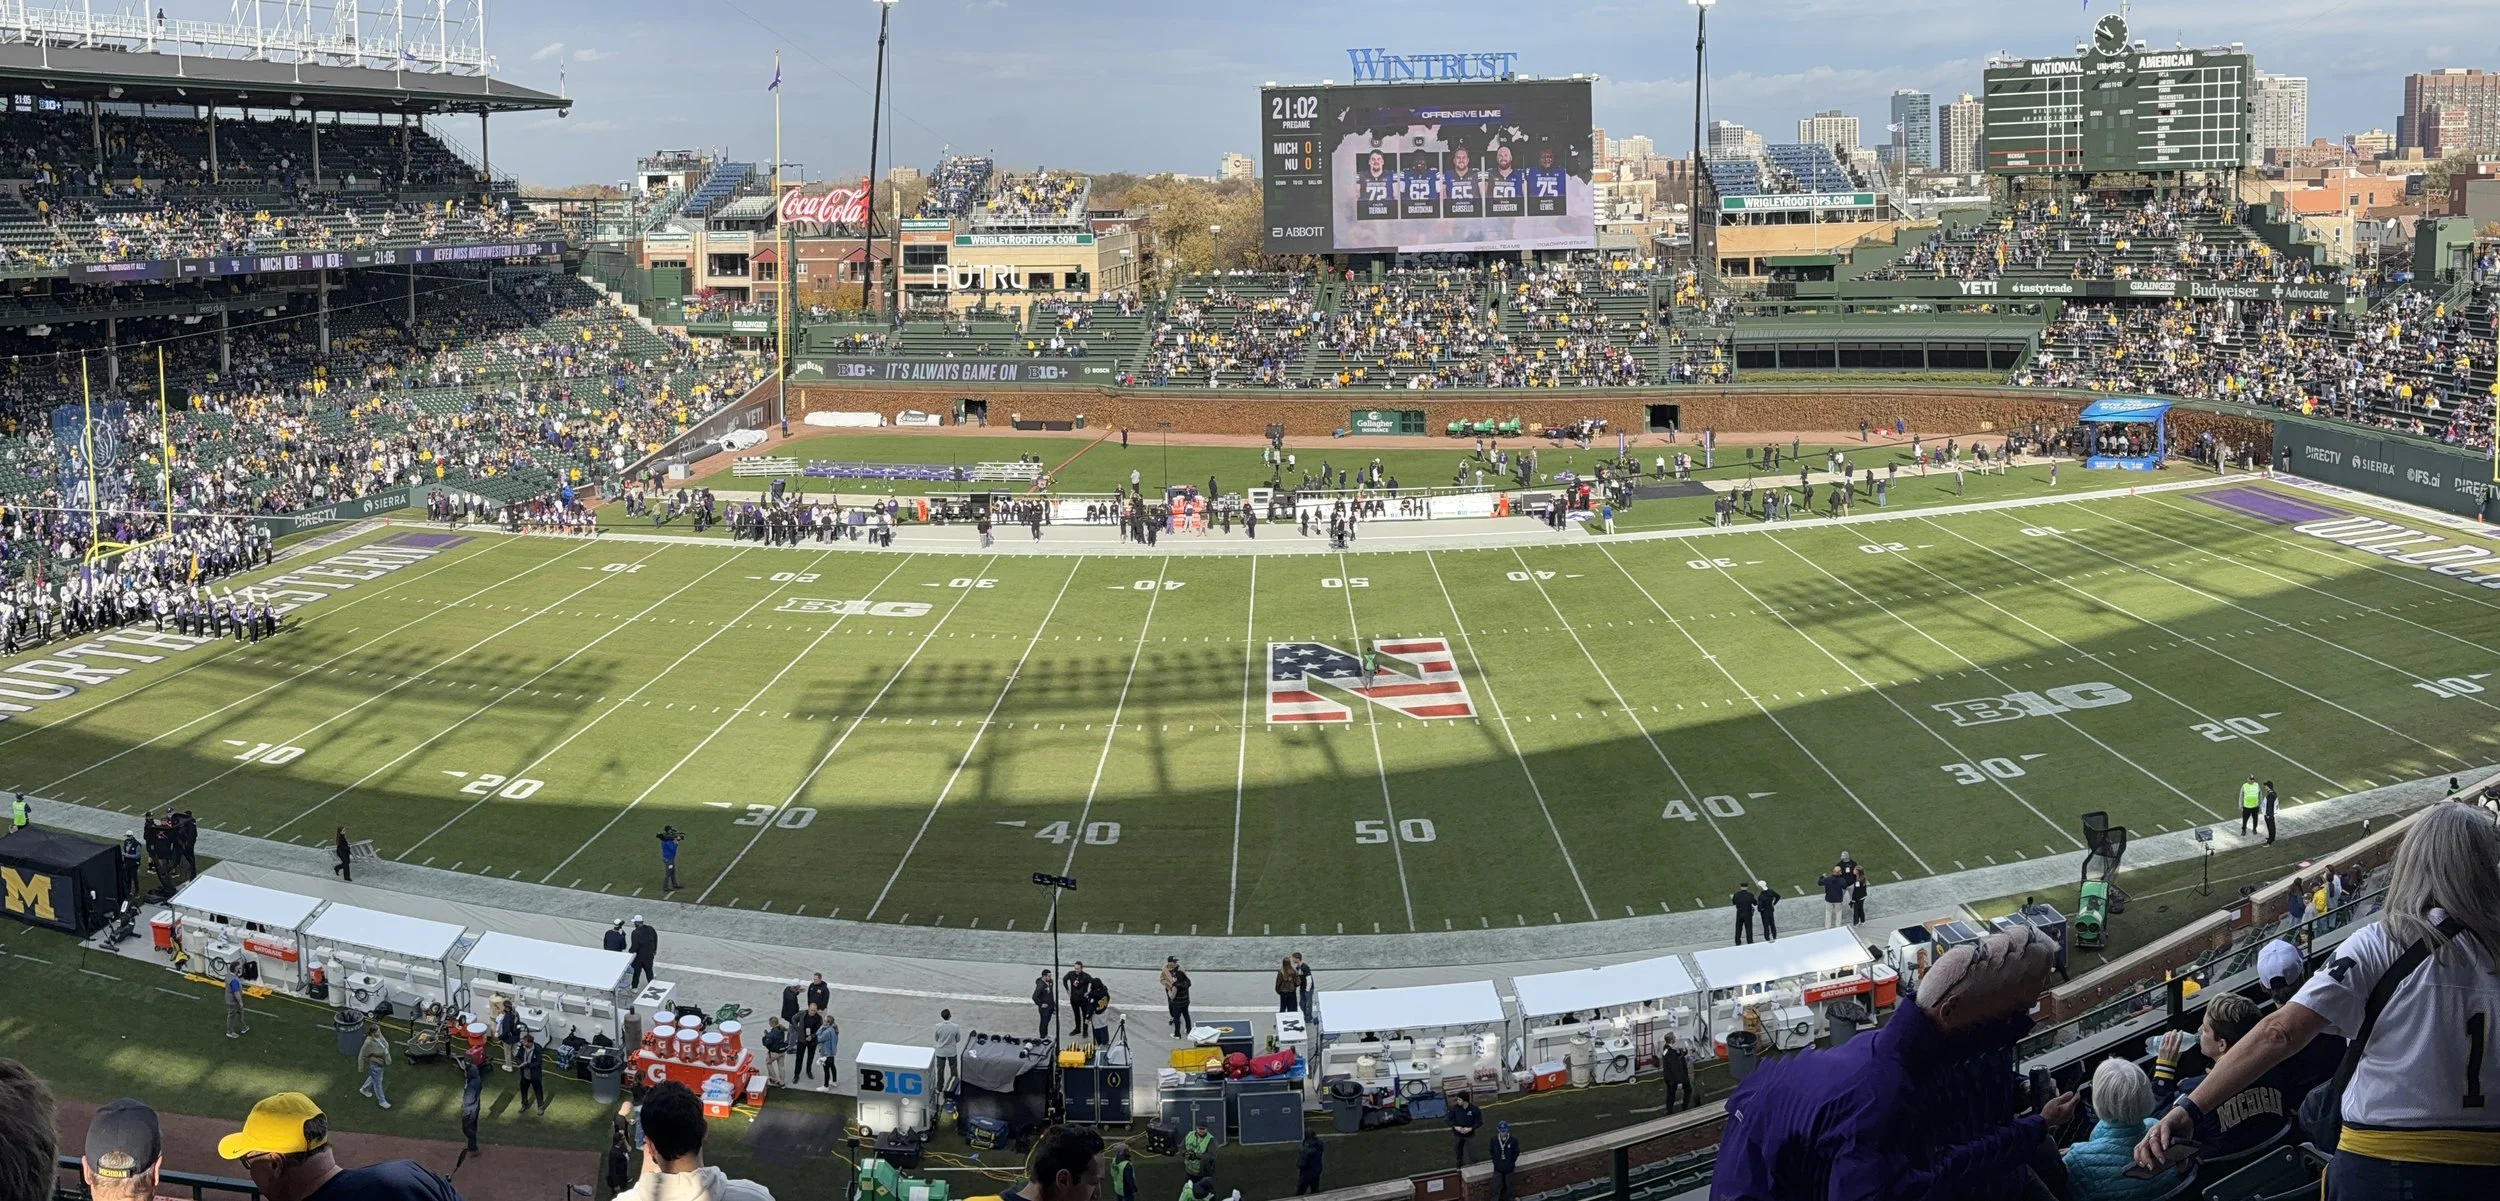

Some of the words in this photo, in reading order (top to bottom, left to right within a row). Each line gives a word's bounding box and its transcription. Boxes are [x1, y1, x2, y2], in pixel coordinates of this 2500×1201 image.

[1347, 48, 1518, 82] WINTRUST
[2032, 61, 2084, 75] NATIONAL
[2139, 54, 2194, 69] AMERICAN
[1272, 96, 1318, 119] 21:02
[1422, 110, 1477, 119] OFFENSIVE
[1478, 109, 1502, 118] LINE
[1282, 120, 1310, 128] PREGAME
[1274, 142, 1298, 155] MICH
[1304, 141, 1312, 154] 0
[1284, 158, 1298, 171] NU
[1304, 157, 1312, 170] 0
[1366, 186, 1387, 200] 72
[1410, 184, 1430, 200] 62
[1536, 181, 1558, 197] 75
[780, 187, 871, 224] Coca-Cola
[1744, 194, 1854, 210] WRIGLEYROOFTOPS.COM
[563, 210, 592, 219] WINNER
[562, 220, 593, 230] TAKES
[1286, 227, 1324, 237] ABBOTT
[552, 242, 556, 253] N
[970, 235, 1078, 246] WRIGLEYROOFTOPS.COM
[375, 250, 396, 264] 21:05
[416, 250, 422, 262] N
[434, 248, 452, 260] NEVER
[452, 247, 468, 258] MISS
[468, 246, 512, 258] NORTHWESTERN
[512, 246, 520, 256] ON
[260, 258, 282, 272] MICH
[312, 255, 323, 268] NU
[1958, 282, 1998, 295] YETI
[2019, 283, 2073, 296] tastytrade
[2130, 282, 2176, 291] GRAINGER
[2191, 284, 2259, 298] Budweiser
[2285, 288, 2330, 300] Advocate
[795, 362, 808, 374] JIM
[807, 361, 824, 375] BEAM
[886, 363, 910, 380] IT'S
[912, 363, 960, 380] ALWAYS
[962, 363, 997, 381] GAME
[1000, 364, 1018, 382] ON
[746, 406, 764, 428] YETI
[1357, 420, 1393, 428] Gallagher
[2306, 445, 2342, 465] DIRECTV
[2362, 458, 2396, 476] SIERRA
[2415, 469, 2440, 488] IFS.ai
[374, 494, 407, 510] SIERRA
[294, 507, 337, 529] DIRECTV
[1857, 542, 1910, 554] 20
[600, 563, 647, 574] 10
[1686, 557, 1738, 569] 30
[768, 572, 821, 583] 20
[1506, 570, 1557, 581] 40
[948, 578, 1000, 589] 30
[1133, 580, 1186, 591] 40
[1321, 578, 1370, 588] 50
[1266, 637, 1478, 723] N
[2413, 676, 2485, 699] 10
[2190, 717, 2270, 743] 20
[235, 742, 306, 765] 10
[1941, 757, 2027, 785] 30
[460, 773, 545, 799] 20
[1662, 795, 1746, 822] 40
[734, 803, 818, 830] 30
[1033, 820, 1122, 847] 40
[1355, 818, 1437, 845] 50
[0, 866, 55, 921] M
[1820, 985, 1858, 999] GATORADE
[658, 1041, 666, 1049] G
[684, 1044, 691, 1052] G
[708, 1048, 716, 1056] G
[2462, 1012, 2487, 1108] 1
[647, 1064, 667, 1083] G
[712, 1106, 720, 1114] G
